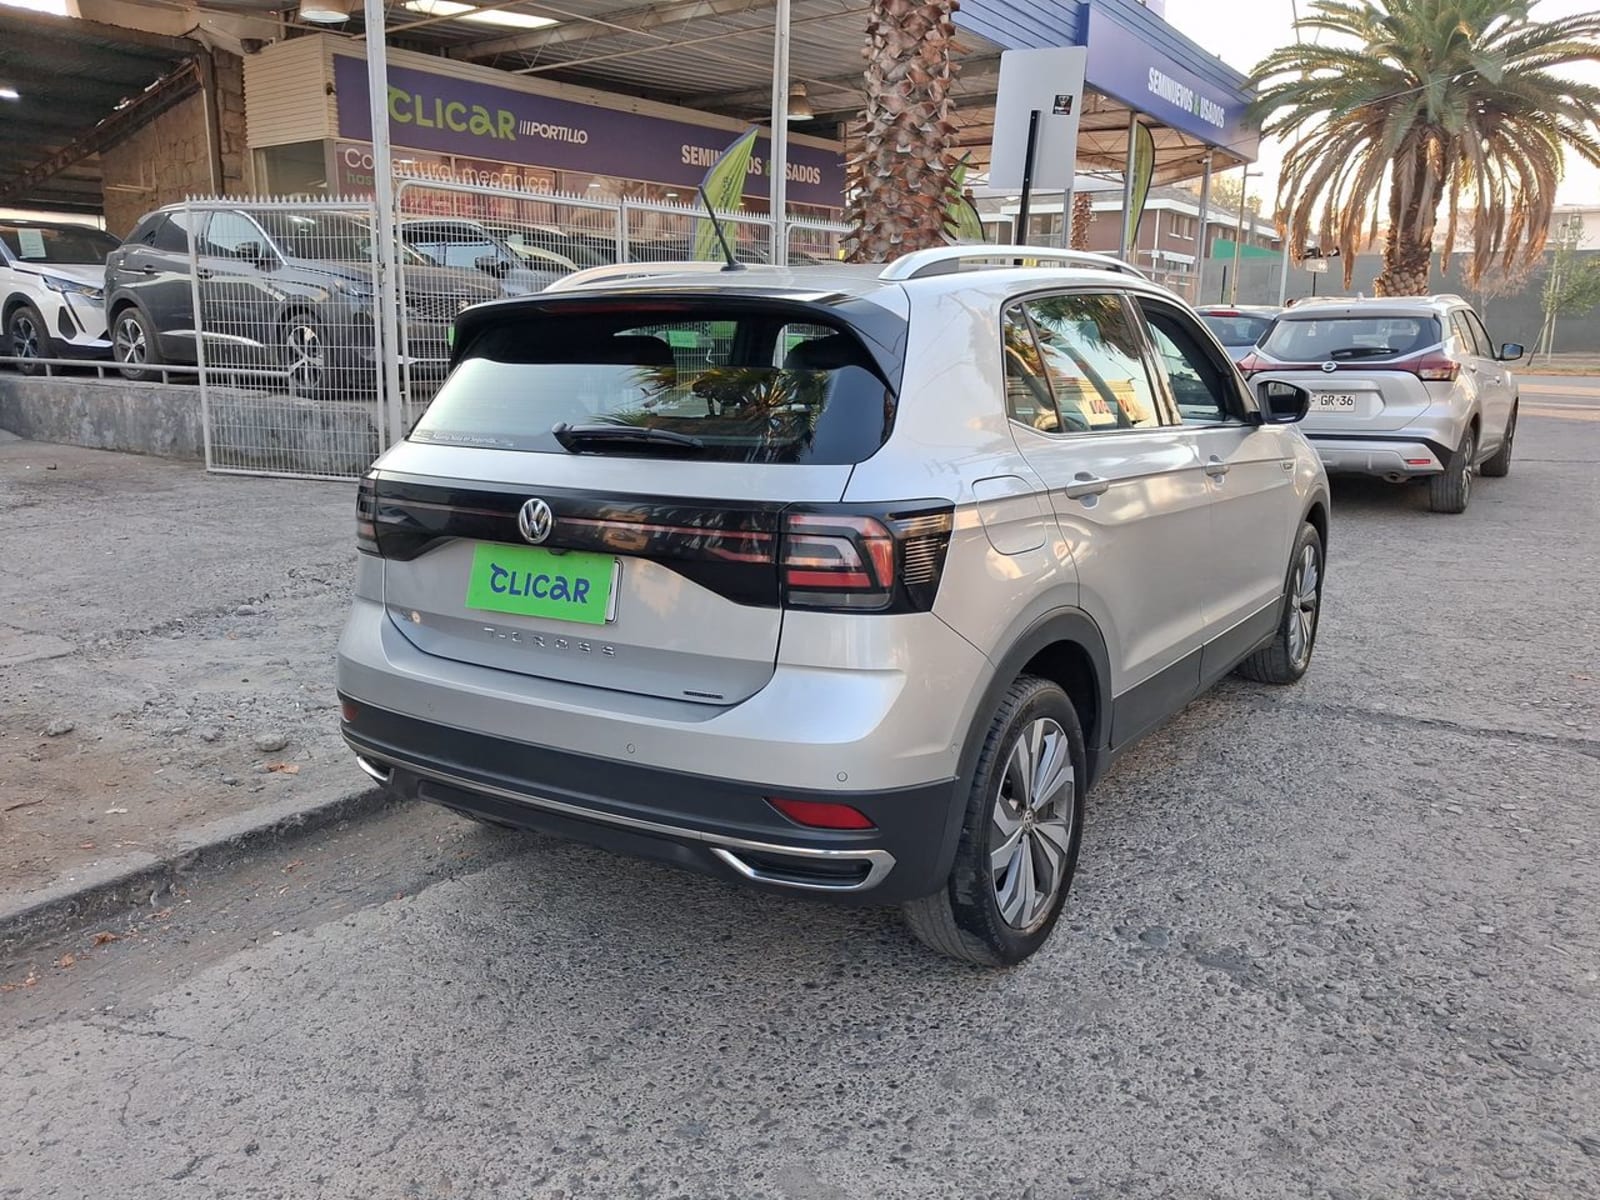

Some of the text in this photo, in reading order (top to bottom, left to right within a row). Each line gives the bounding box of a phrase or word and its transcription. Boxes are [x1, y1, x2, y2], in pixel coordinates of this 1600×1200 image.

[344, 148, 453, 181] Coertura
[681, 144, 762, 175] SEMINOS
[785, 162, 821, 185] SADOS
[484, 626, 615, 657] T-CROSS
